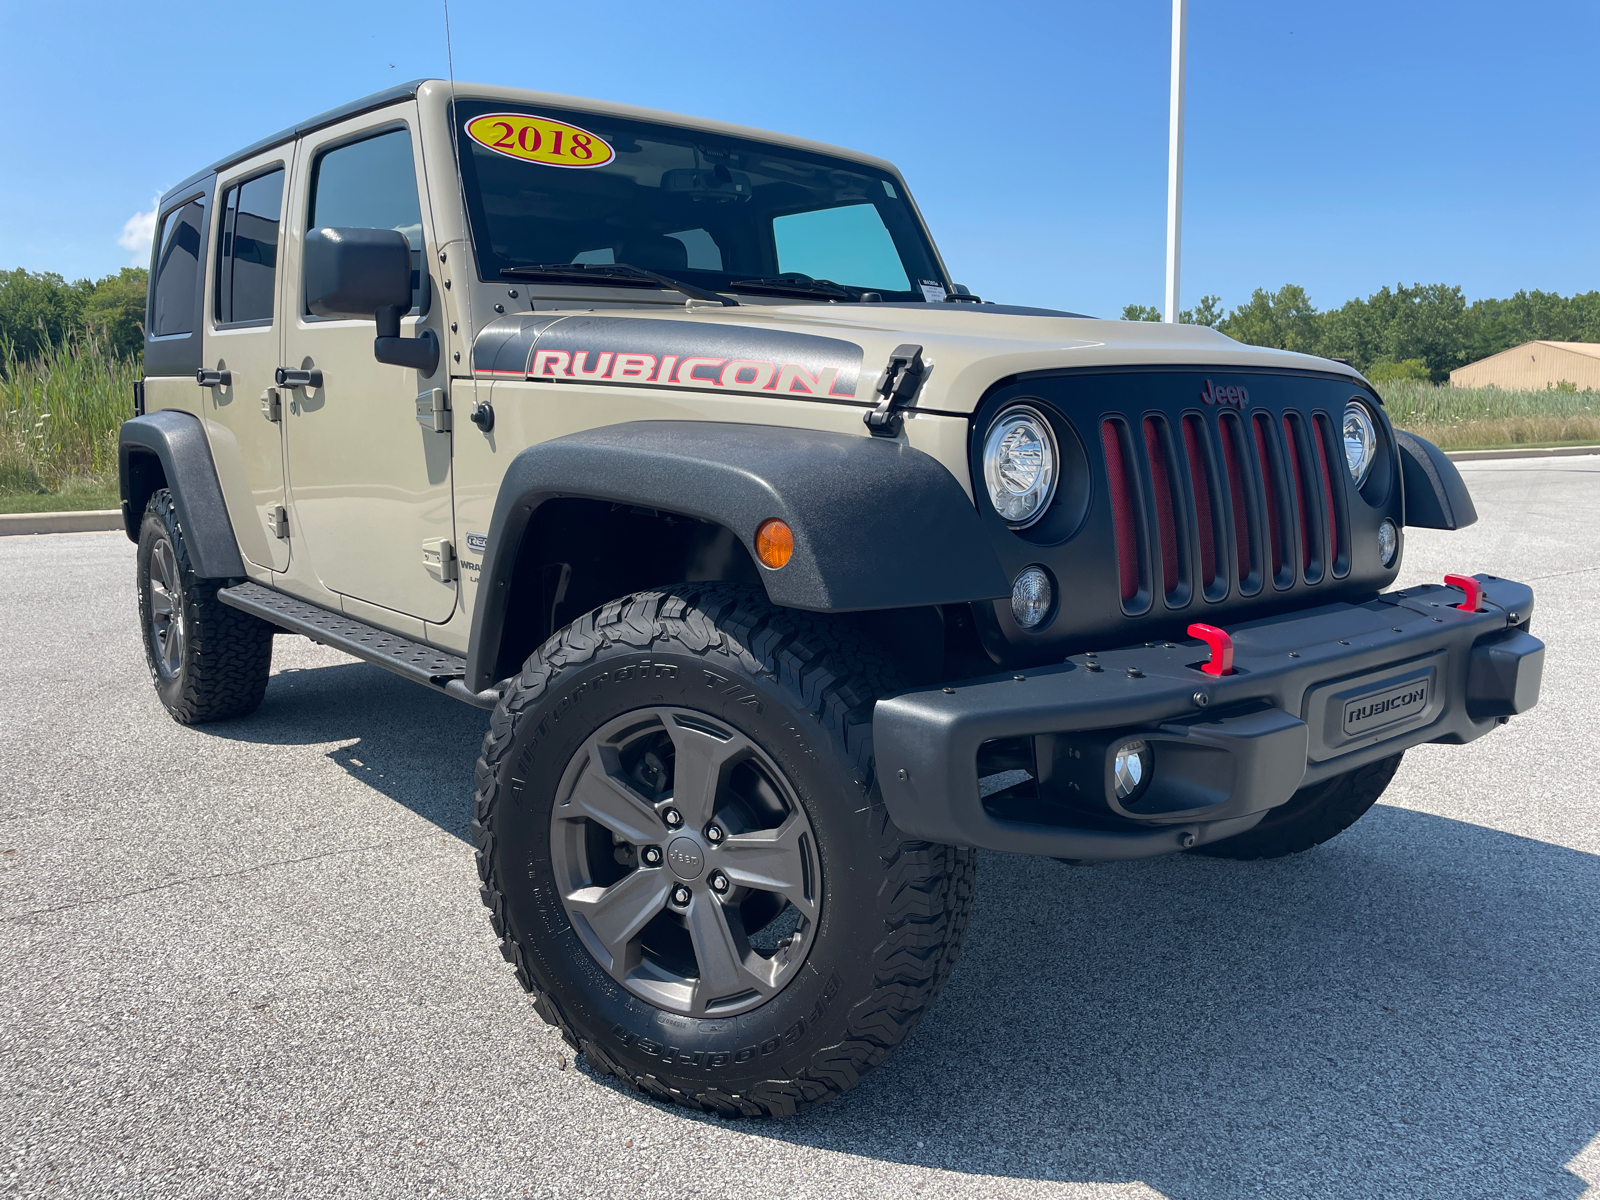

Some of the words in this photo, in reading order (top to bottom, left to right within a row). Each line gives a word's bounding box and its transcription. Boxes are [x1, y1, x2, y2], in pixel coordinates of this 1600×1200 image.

[491, 121, 593, 160] 2018
[530, 349, 852, 397] RUBICON
[1201, 379, 1250, 410] Jeep
[460, 560, 482, 571] WRA
[1348, 688, 1424, 724] RUBICON
[670, 849, 699, 867] Jeep
